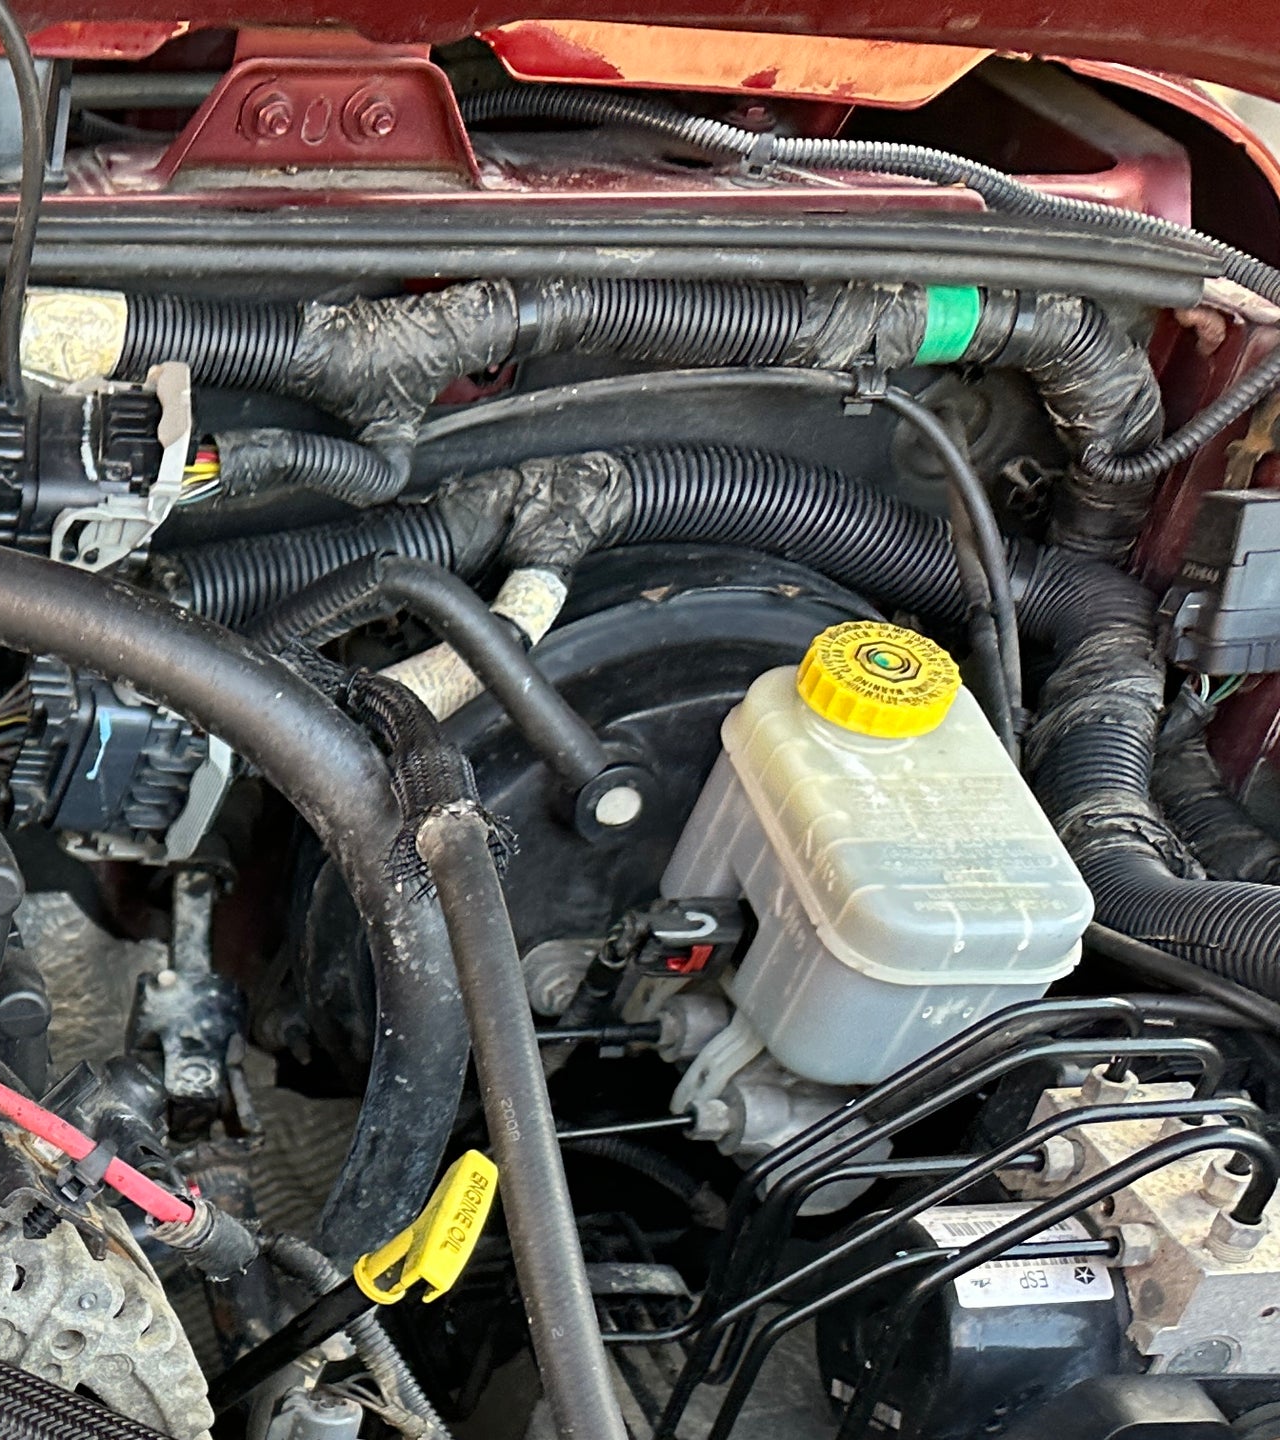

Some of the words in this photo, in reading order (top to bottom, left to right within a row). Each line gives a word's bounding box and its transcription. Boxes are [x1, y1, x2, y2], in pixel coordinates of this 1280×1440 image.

[454, 1171, 489, 1229] ENGINE
[439, 1226, 466, 1254] OIL
[1020, 1269, 1049, 1289] ESP
